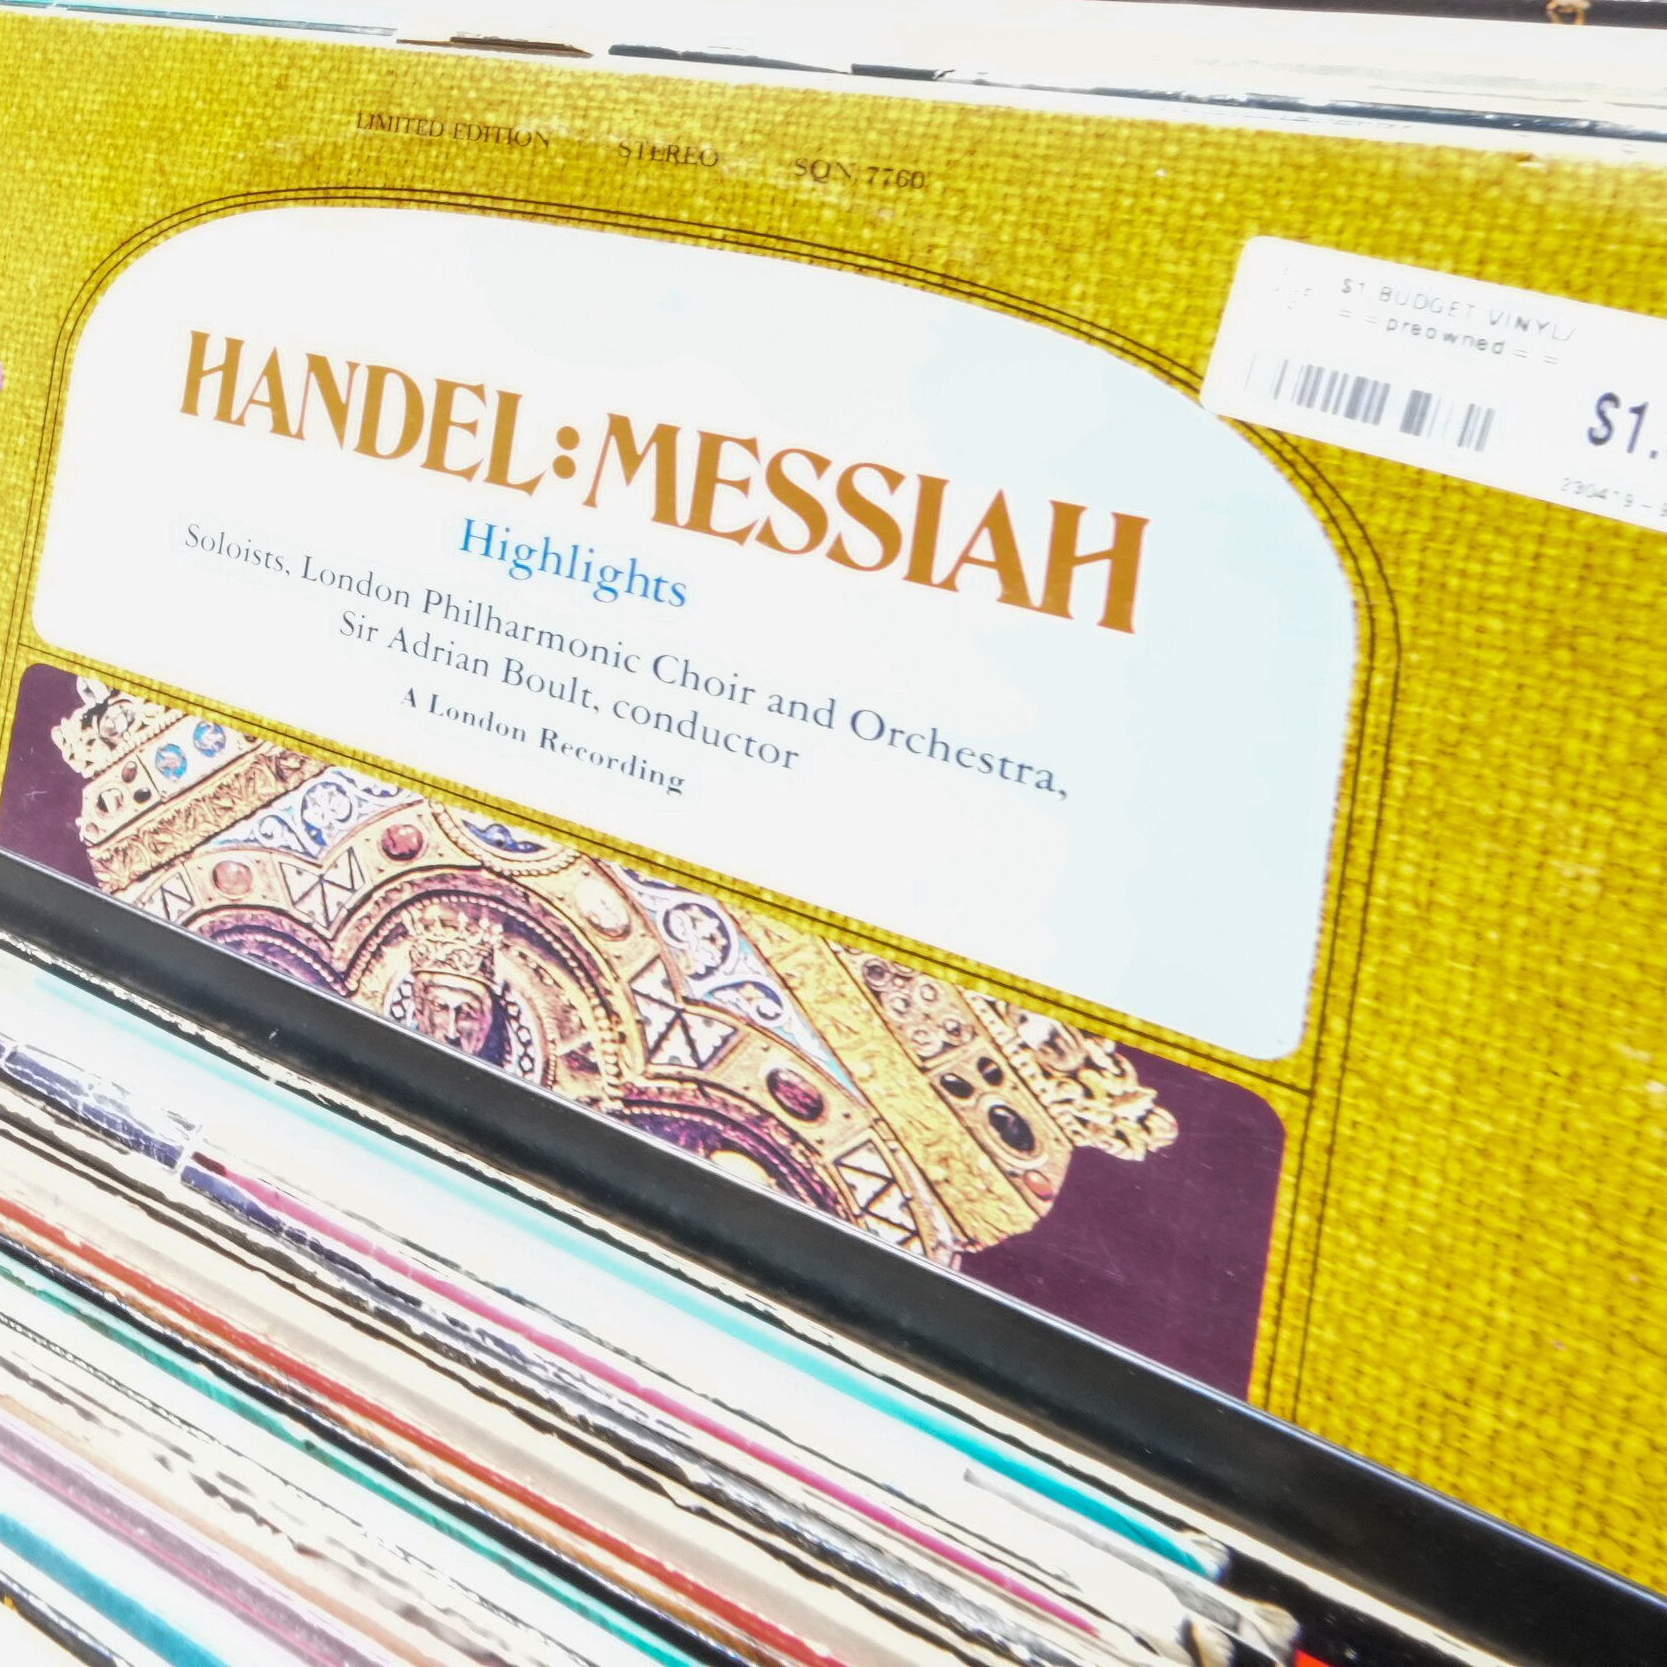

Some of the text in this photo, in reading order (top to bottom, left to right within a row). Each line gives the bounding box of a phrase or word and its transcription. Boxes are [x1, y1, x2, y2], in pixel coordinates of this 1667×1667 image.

[355, 111, 926, 192] LIMITED EDITION STEREO SQN 7760
[1340, 277, 1366, 296] $1
[1378, 285, 1477, 320] BUDGET
[1586, 390, 1667, 460] $1.
[458, 517, 687, 608] Highlights
[184, 523, 1069, 802] Soloists, London Philharmonic Choir and Orchestra,
[339, 610, 800, 770] Sir Adrian Boult, conductor
[400, 686, 687, 797] A London Recording
